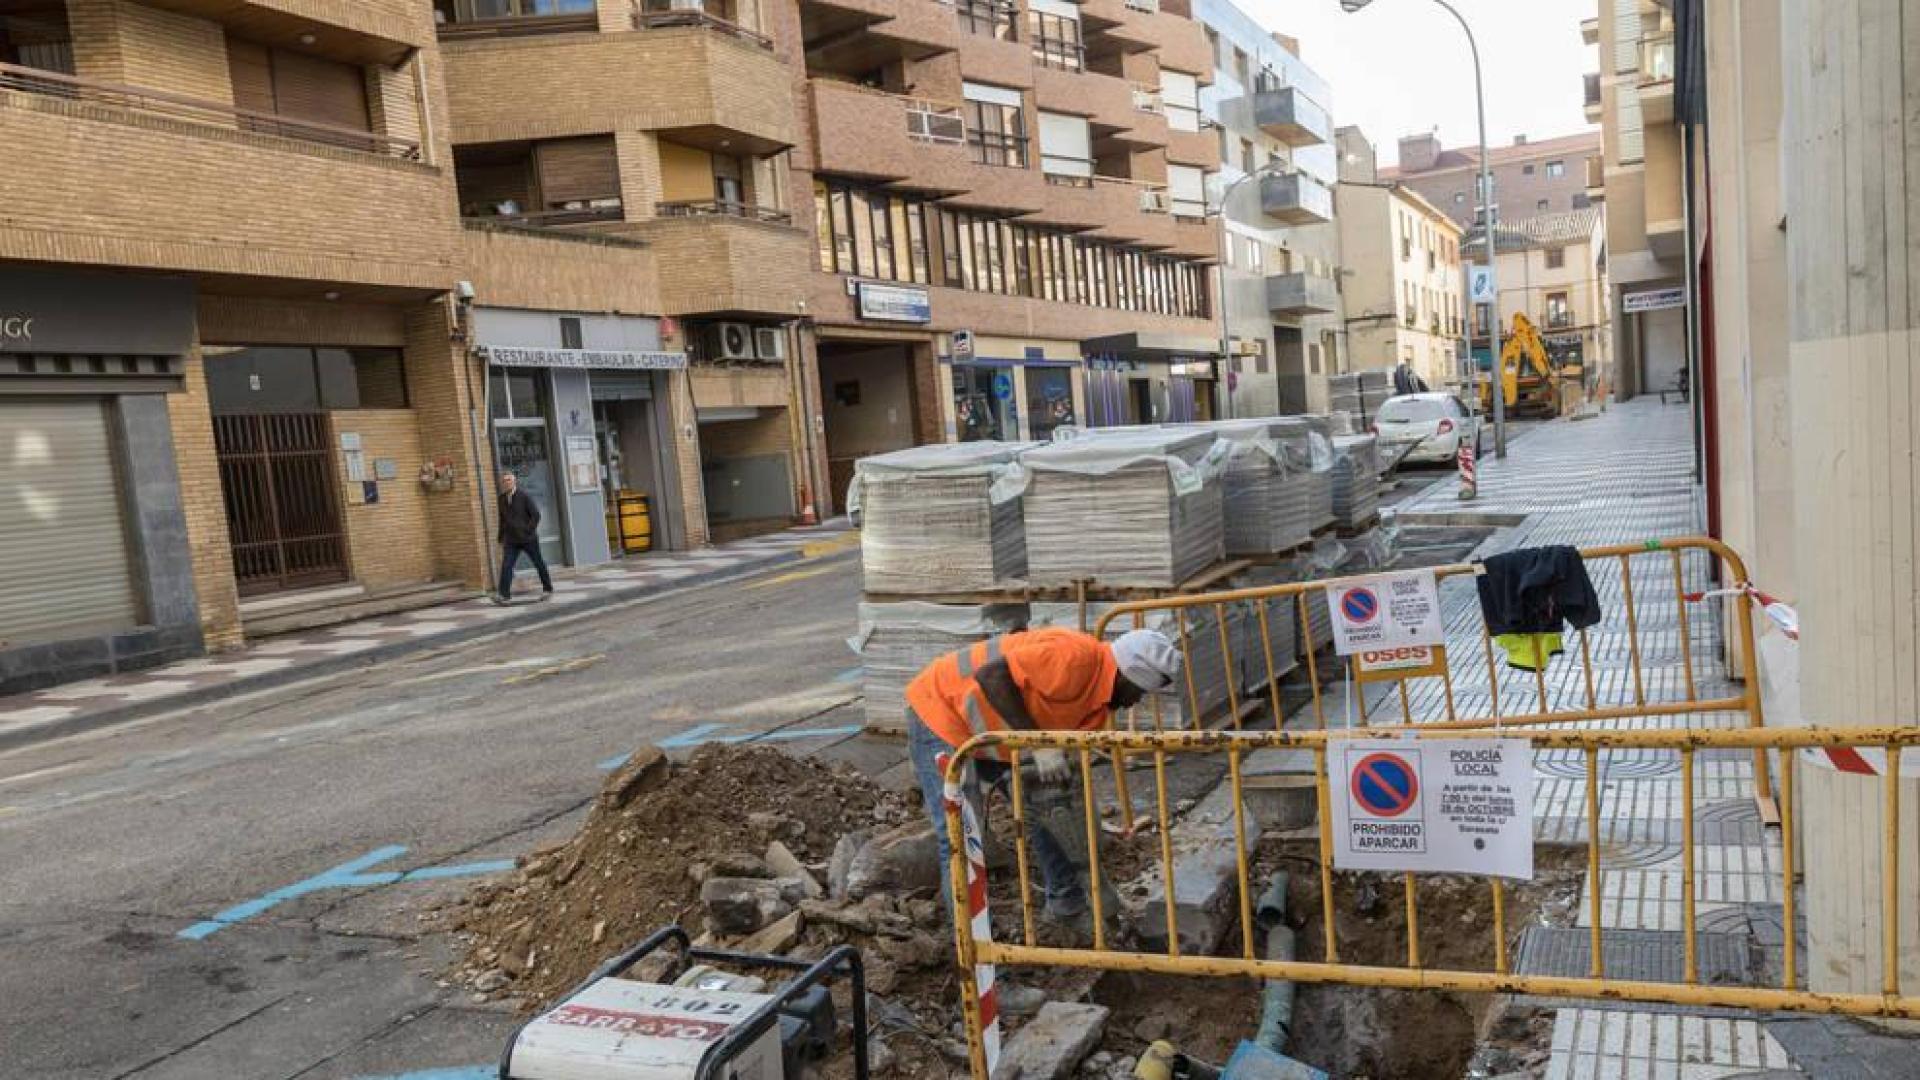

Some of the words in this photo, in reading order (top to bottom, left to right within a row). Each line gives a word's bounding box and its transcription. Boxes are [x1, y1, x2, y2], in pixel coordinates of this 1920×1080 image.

[494, 350, 576, 364] RESTAURANTE
[1454, 764, 1498, 775] LOCAL
[1443, 784, 1451, 792] A
[1453, 785, 1479, 793] partir
[1353, 823, 1421, 835] PROHIBIDO
[1359, 837, 1418, 849] APARCAR
